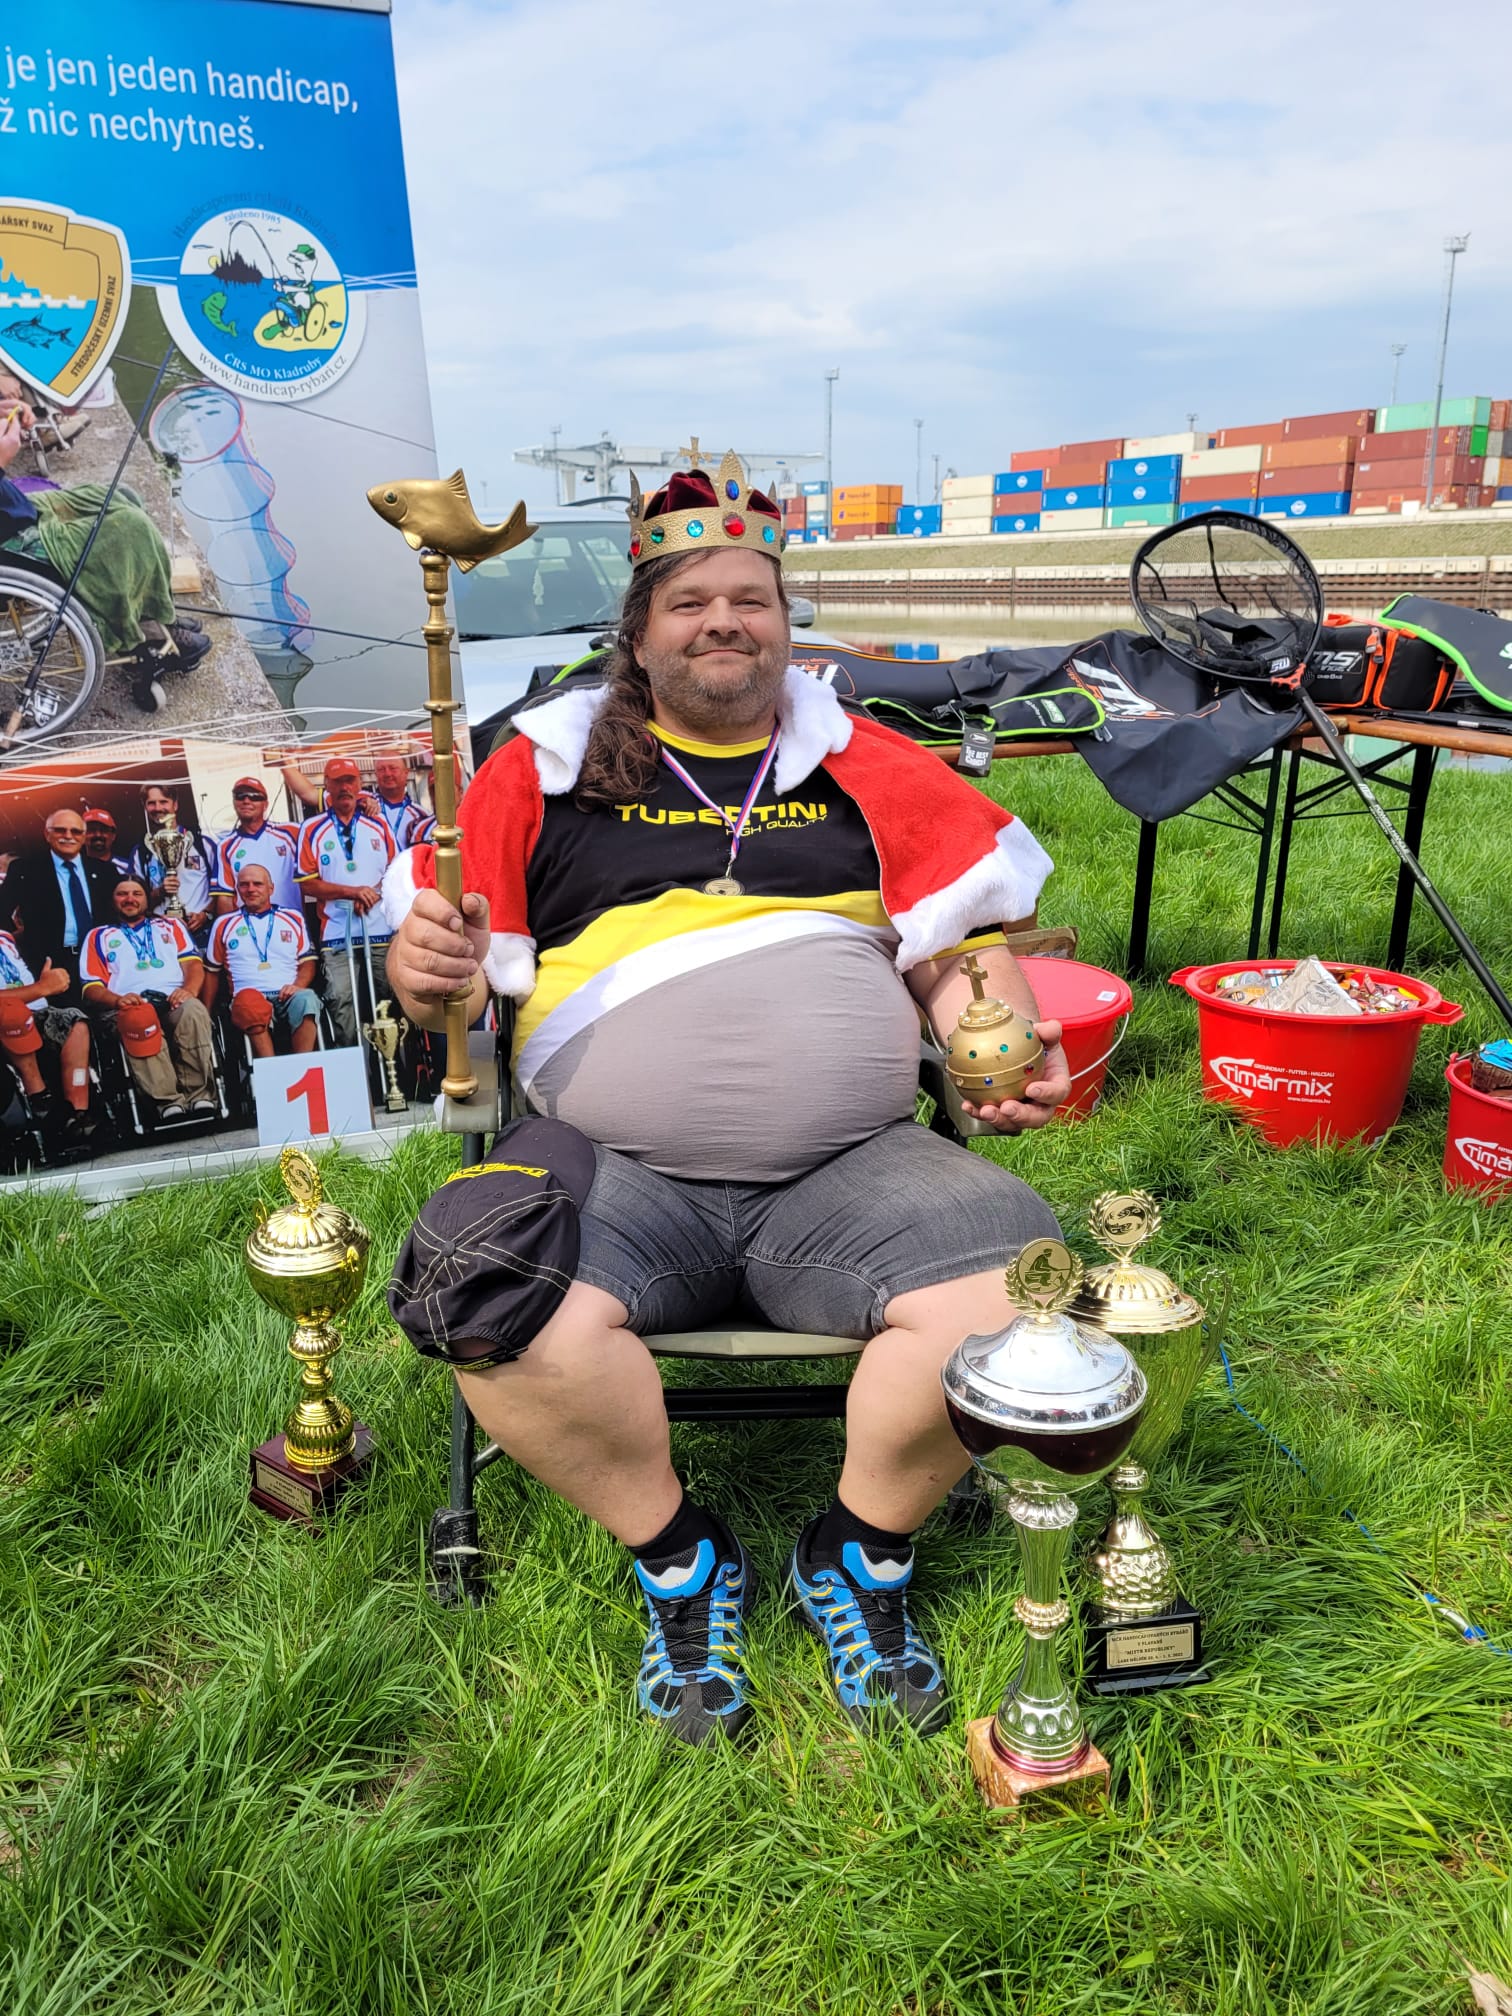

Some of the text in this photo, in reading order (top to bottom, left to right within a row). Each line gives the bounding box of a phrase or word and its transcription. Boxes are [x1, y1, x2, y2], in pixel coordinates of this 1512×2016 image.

[6, 46, 359, 114] je jen jeden handicap,
[28, 101, 79, 137] nic
[90, 107, 265, 152] nechytneš.
[32, 220, 54, 234] SVAZ
[107, 275, 116, 296] SVAZ
[199, 352, 347, 398] www.handicap-rybari.cz
[224, 352, 322, 379] ČRS MO Kladruby
[614, 801, 828, 827] TUBERTINI
[726, 814, 828, 837] HGH QUALITY
[286, 1067, 329, 1135] 1
